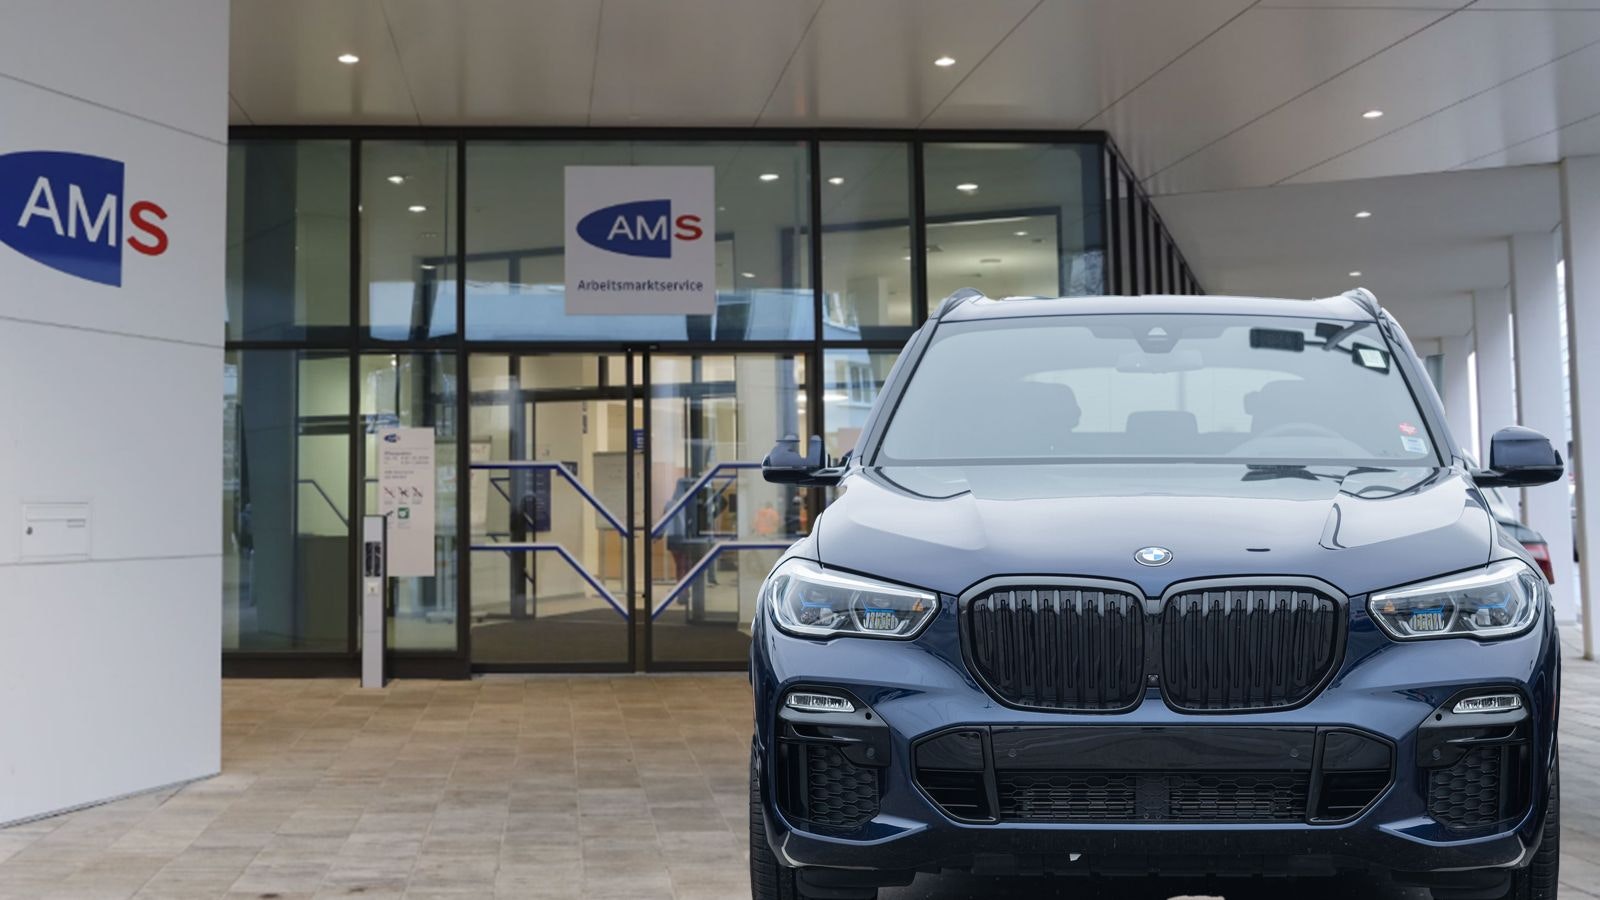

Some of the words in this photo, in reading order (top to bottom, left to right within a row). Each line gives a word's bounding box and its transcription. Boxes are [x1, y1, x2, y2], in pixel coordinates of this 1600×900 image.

[17, 175, 169, 256] AMS
[607, 214, 703, 241] AMS
[577, 279, 703, 292] Arbeitsmarktservice
